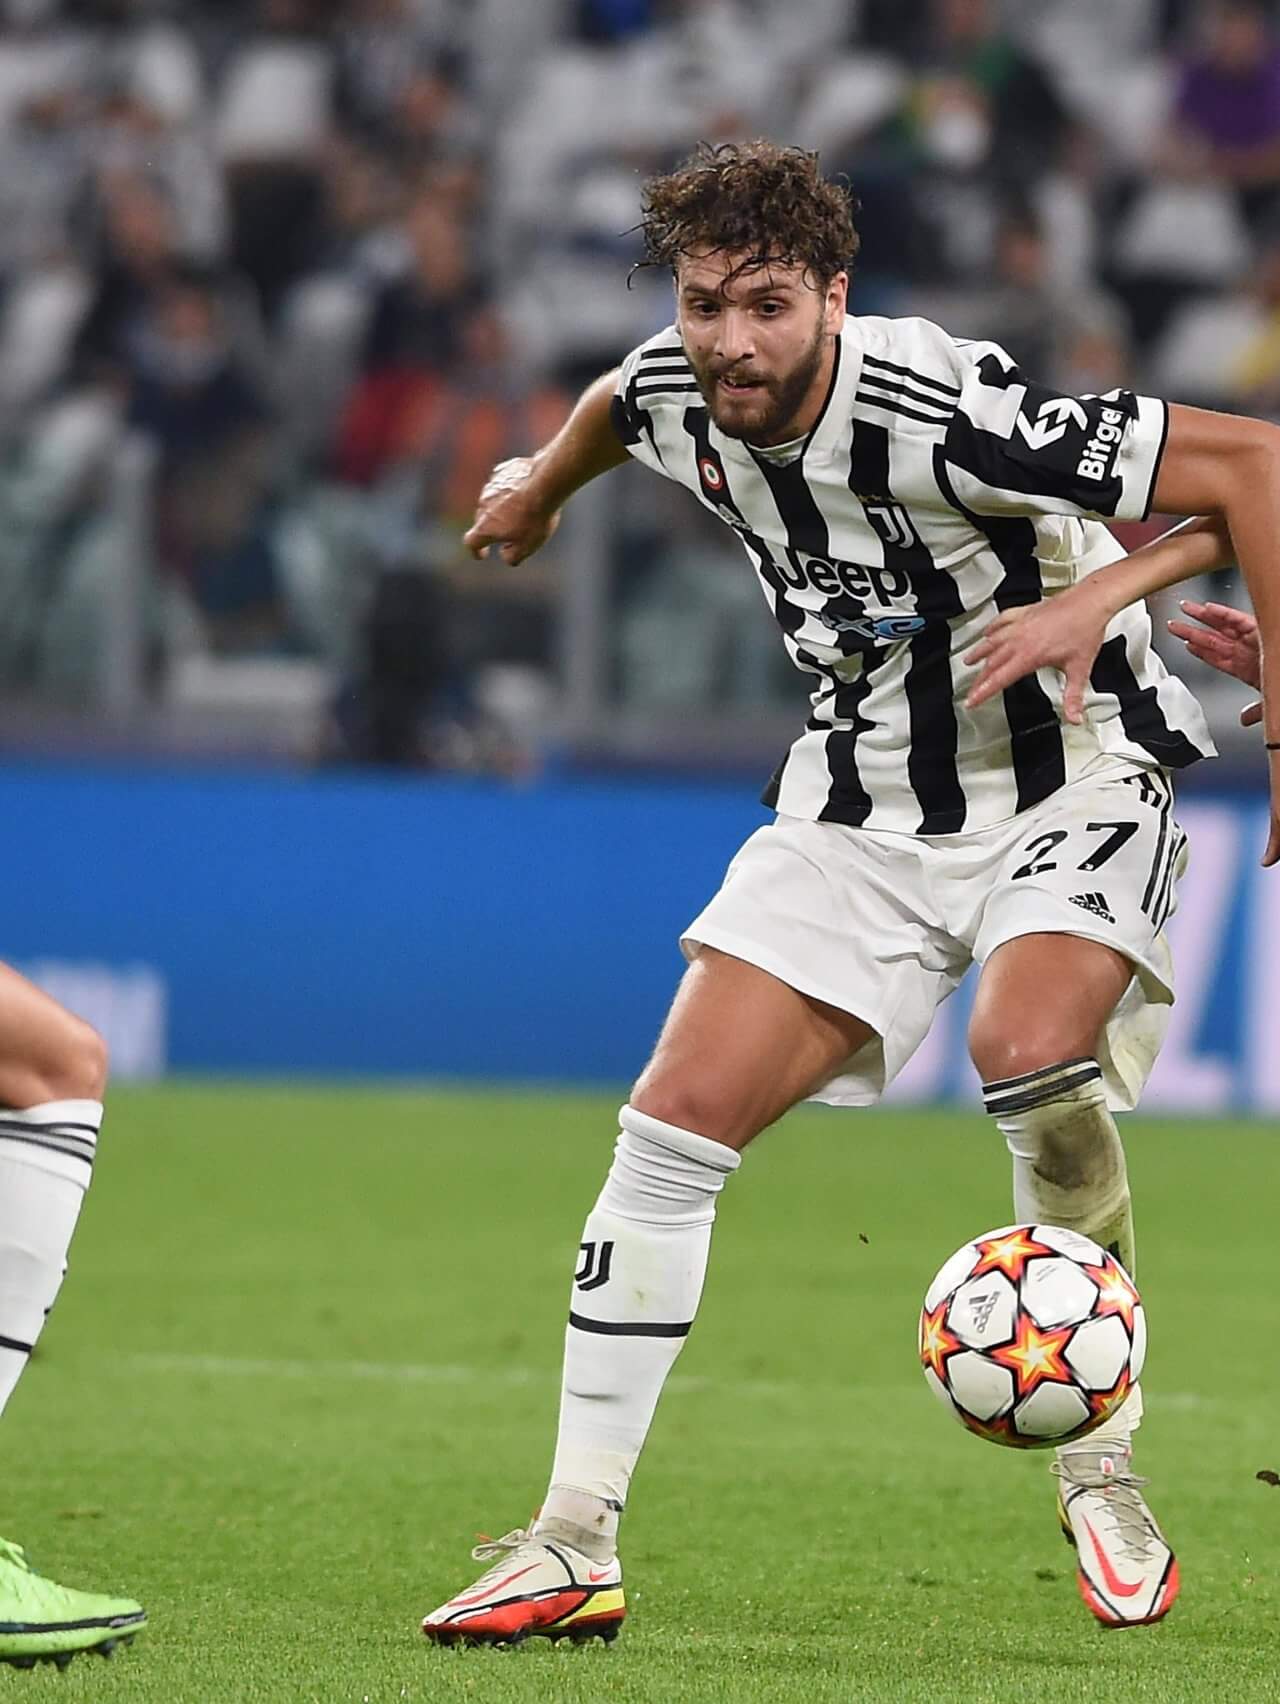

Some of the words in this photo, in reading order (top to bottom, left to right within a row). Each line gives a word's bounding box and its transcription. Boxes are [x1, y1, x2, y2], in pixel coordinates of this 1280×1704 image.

[1076, 405, 1123, 481] Bitge
[774, 547, 912, 607] Jeep
[1010, 821, 1140, 881] 27
[1067, 895, 1117, 925] adidas
